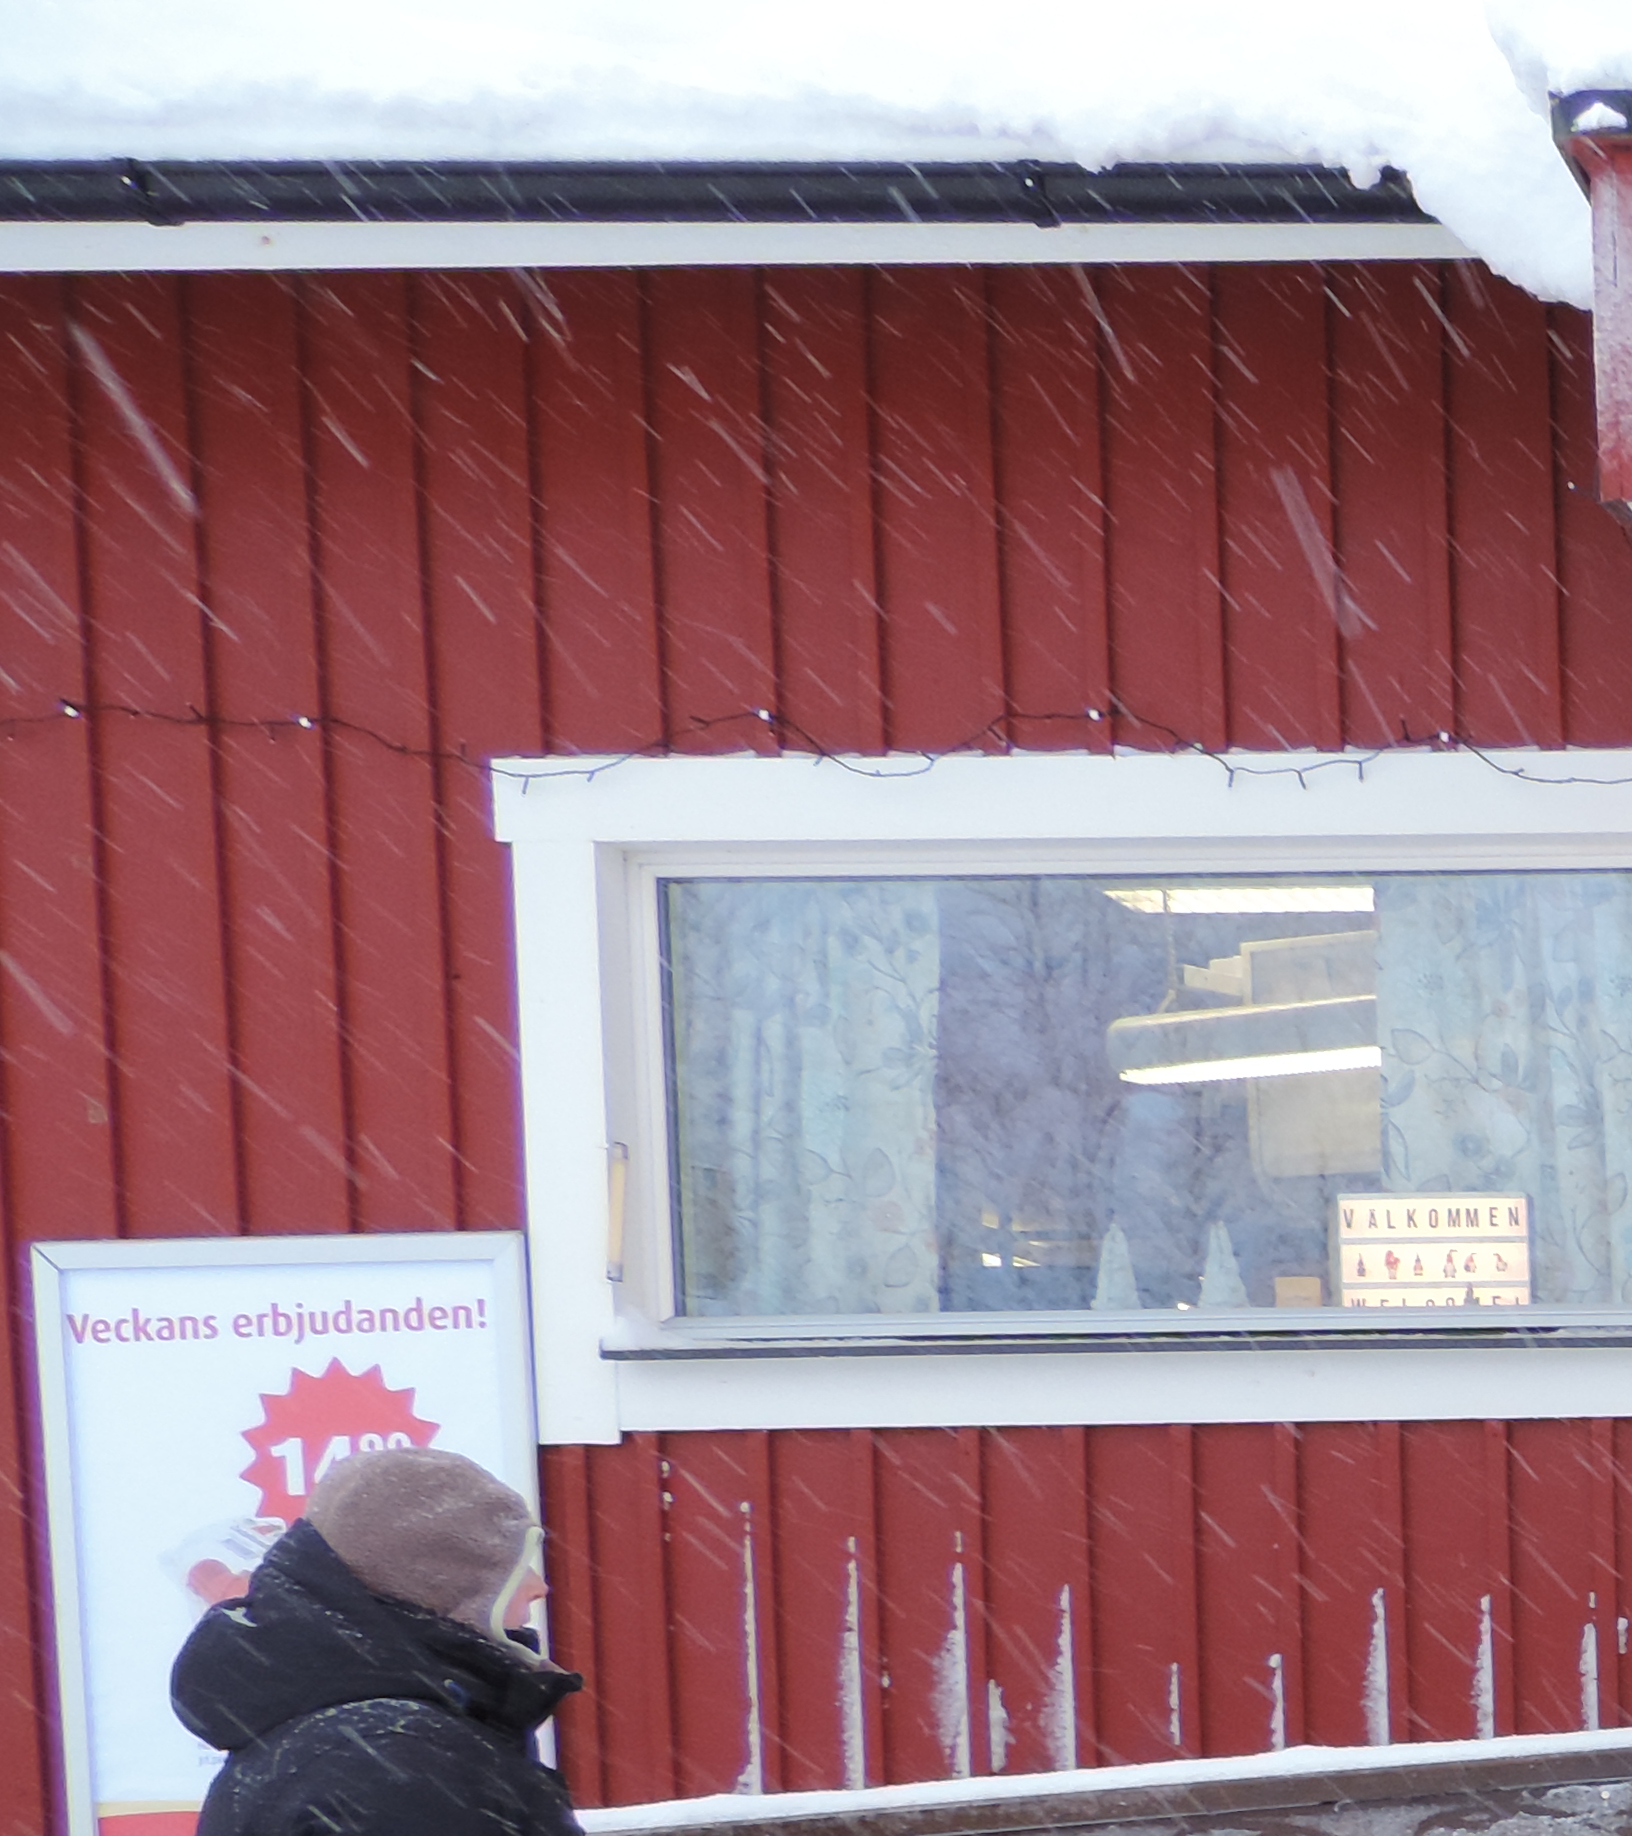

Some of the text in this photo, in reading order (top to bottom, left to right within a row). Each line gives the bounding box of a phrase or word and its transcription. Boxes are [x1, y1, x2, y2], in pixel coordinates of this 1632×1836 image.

[1343, 1206, 1520, 1229] VÄLKOMMEN
[67, 1297, 488, 1345] Veckans erbjudanden!
